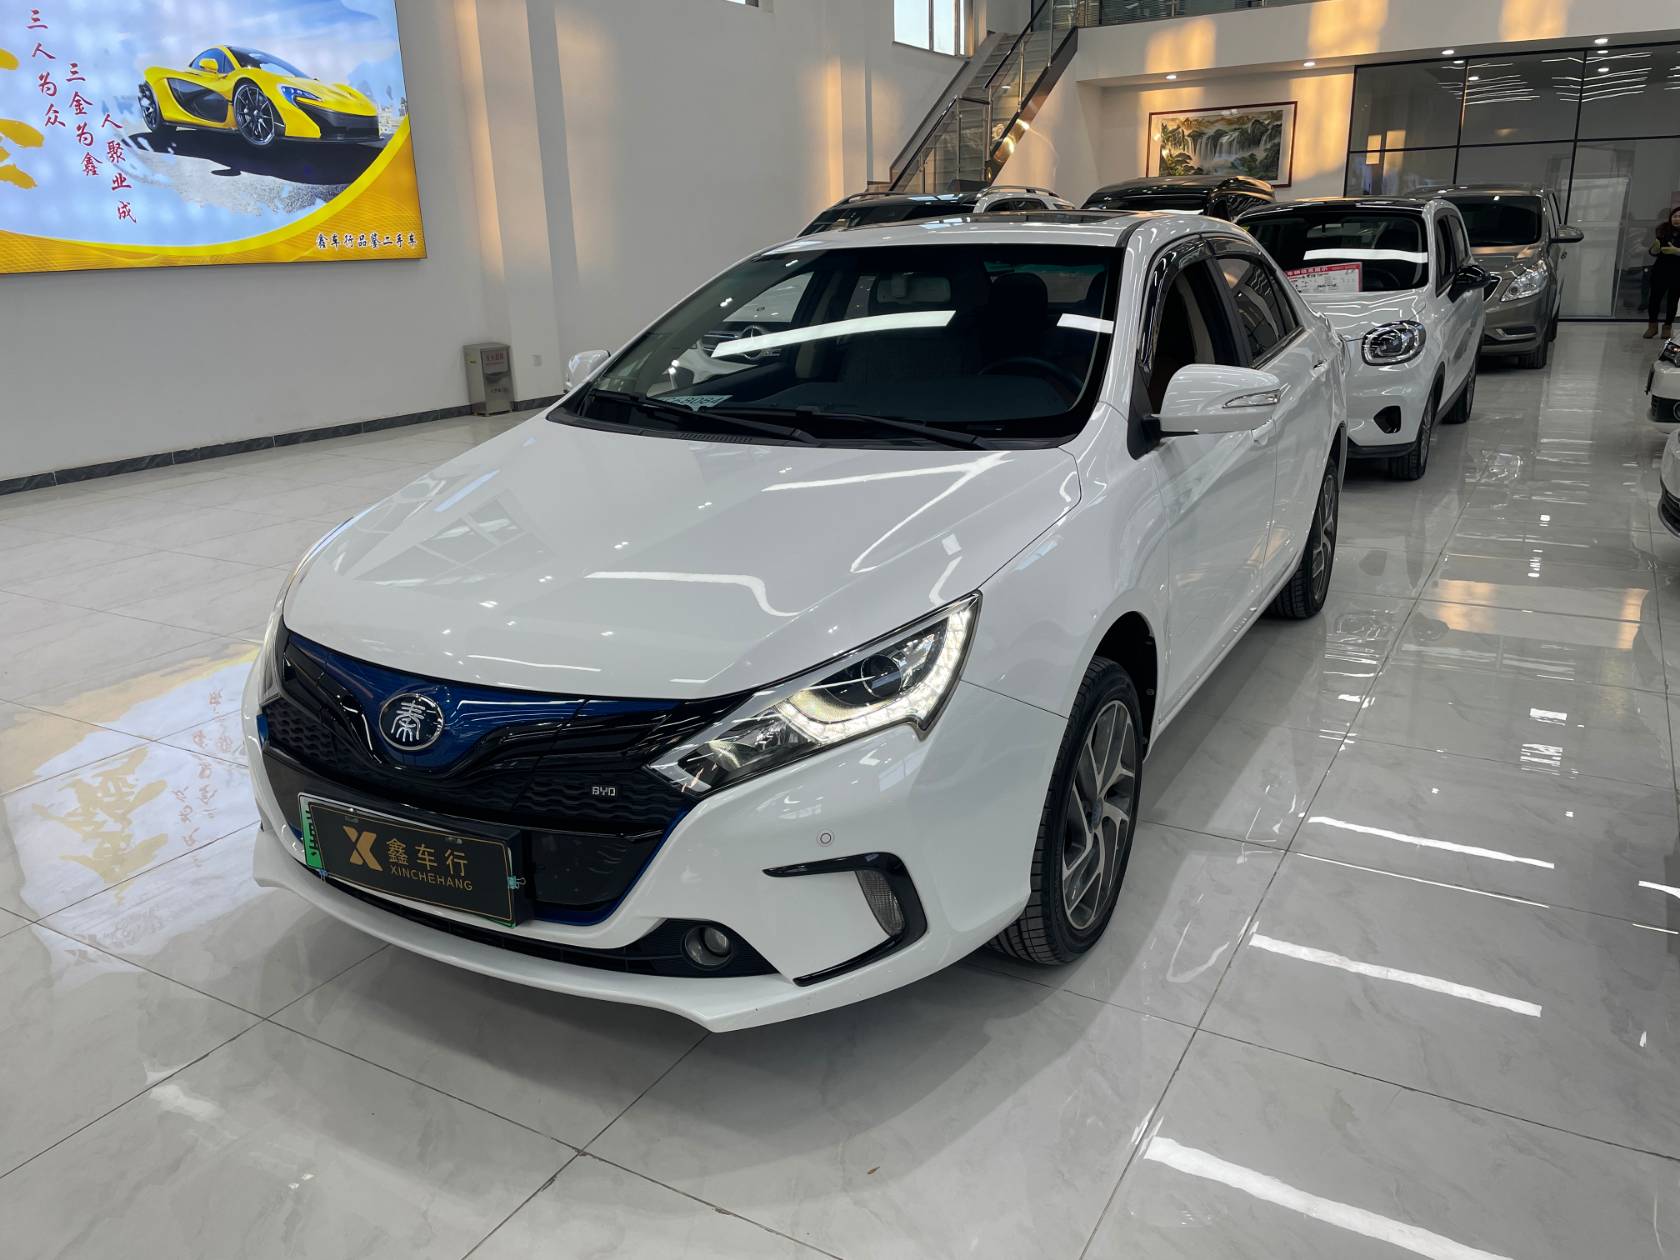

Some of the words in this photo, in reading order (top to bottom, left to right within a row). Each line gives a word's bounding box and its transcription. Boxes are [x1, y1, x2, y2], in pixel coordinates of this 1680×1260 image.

[27, 9, 66, 128] 三人为众
[66, 62, 102, 177] 三金为鑫
[100, 113, 137, 224] 人聚业成
[592, 786, 616, 796] BYD
[386, 838, 468, 877] 鑫车行
[390, 864, 473, 891] XINCHEHANG
